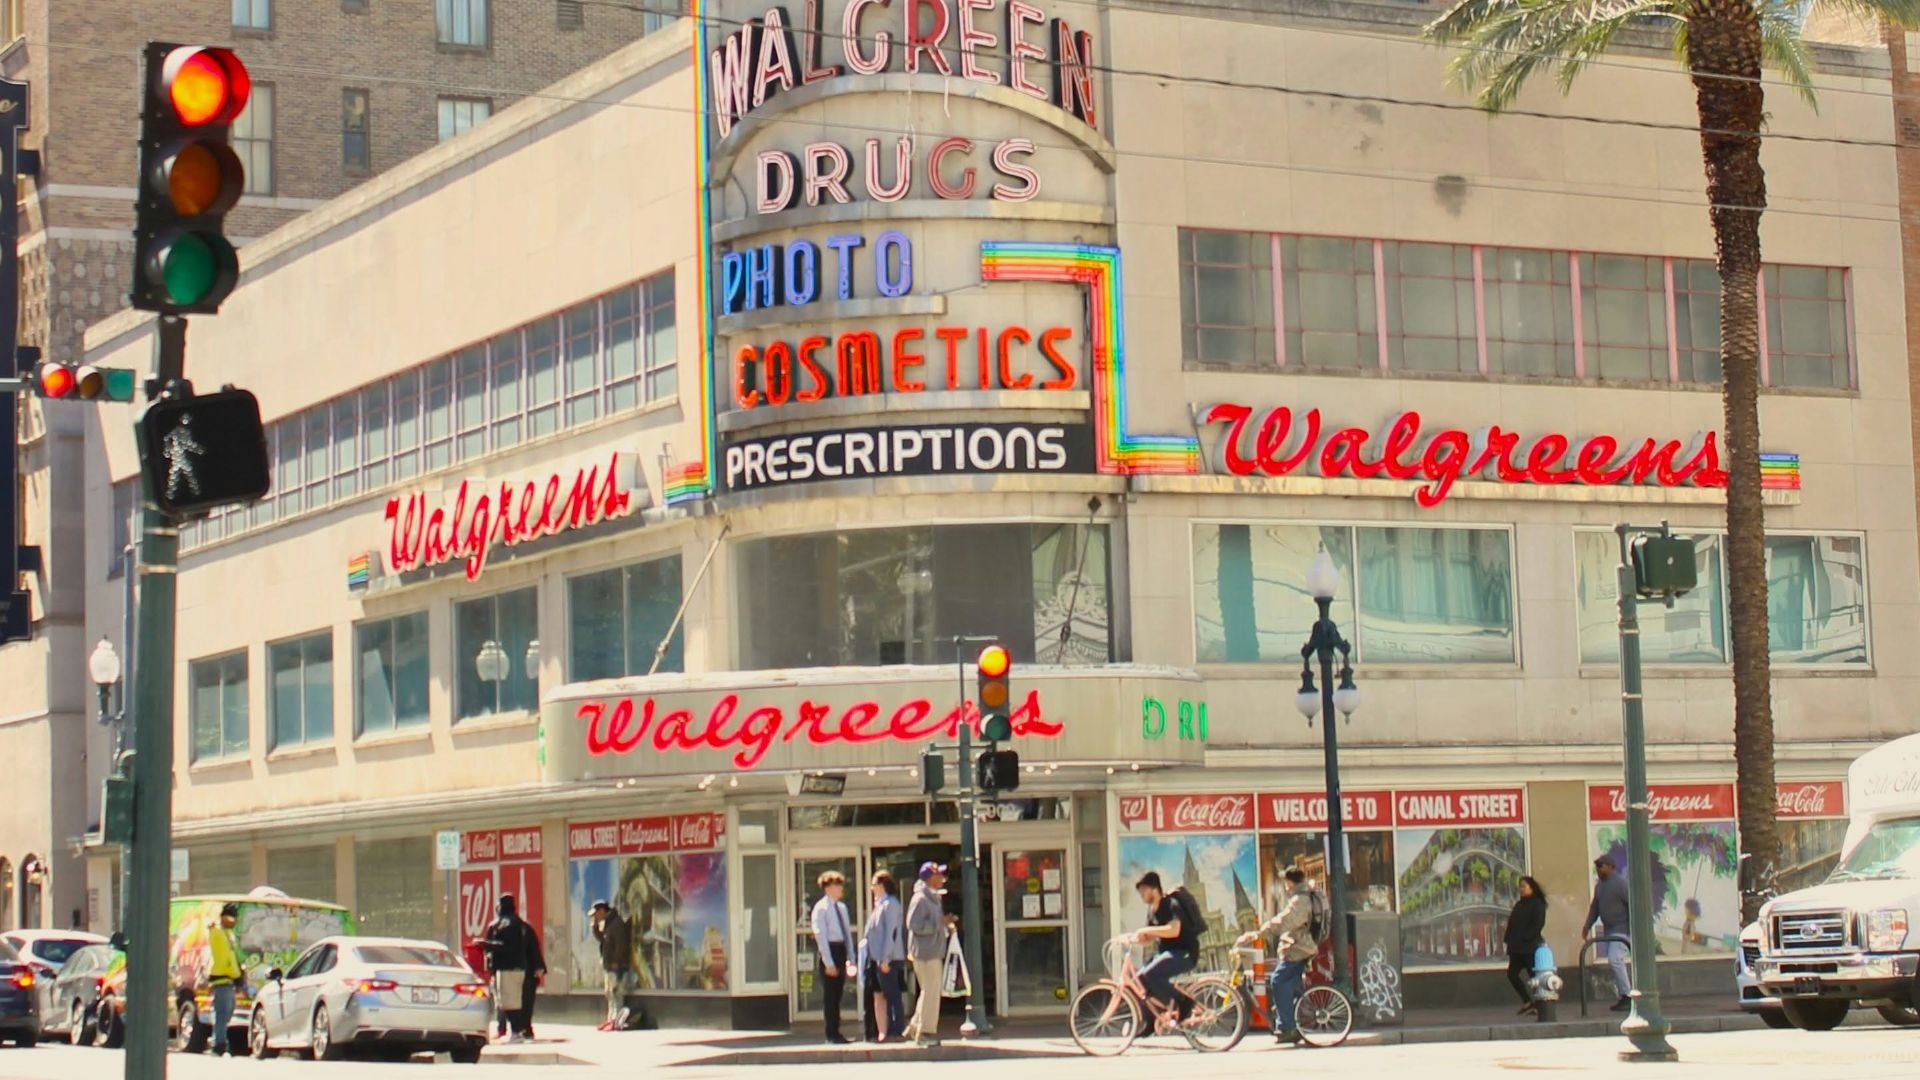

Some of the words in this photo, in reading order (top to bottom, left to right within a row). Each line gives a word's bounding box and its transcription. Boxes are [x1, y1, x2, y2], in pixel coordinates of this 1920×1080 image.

[712, 0, 1096, 139] WALGREEN
[756, 136, 1042, 215] DRUGS
[722, 230, 913, 315] PHOTO
[734, 325, 1078, 409] COSMETICS
[725, 426, 1068, 489] PRESCRIPTIONS
[1204, 402, 1730, 508] Walgreens
[384, 450, 632, 583] Walgreens
[620, 821, 670, 853] Walgreens
[1173, 796, 1250, 828] Coca-Cola
[1272, 797, 1352, 823] WELCOE
[1356, 797, 1378, 821] TO
[1399, 796, 1456, 821] CANAL
[1459, 794, 1518, 819] STREET
[1608, 788, 1715, 820] Wlgreens
